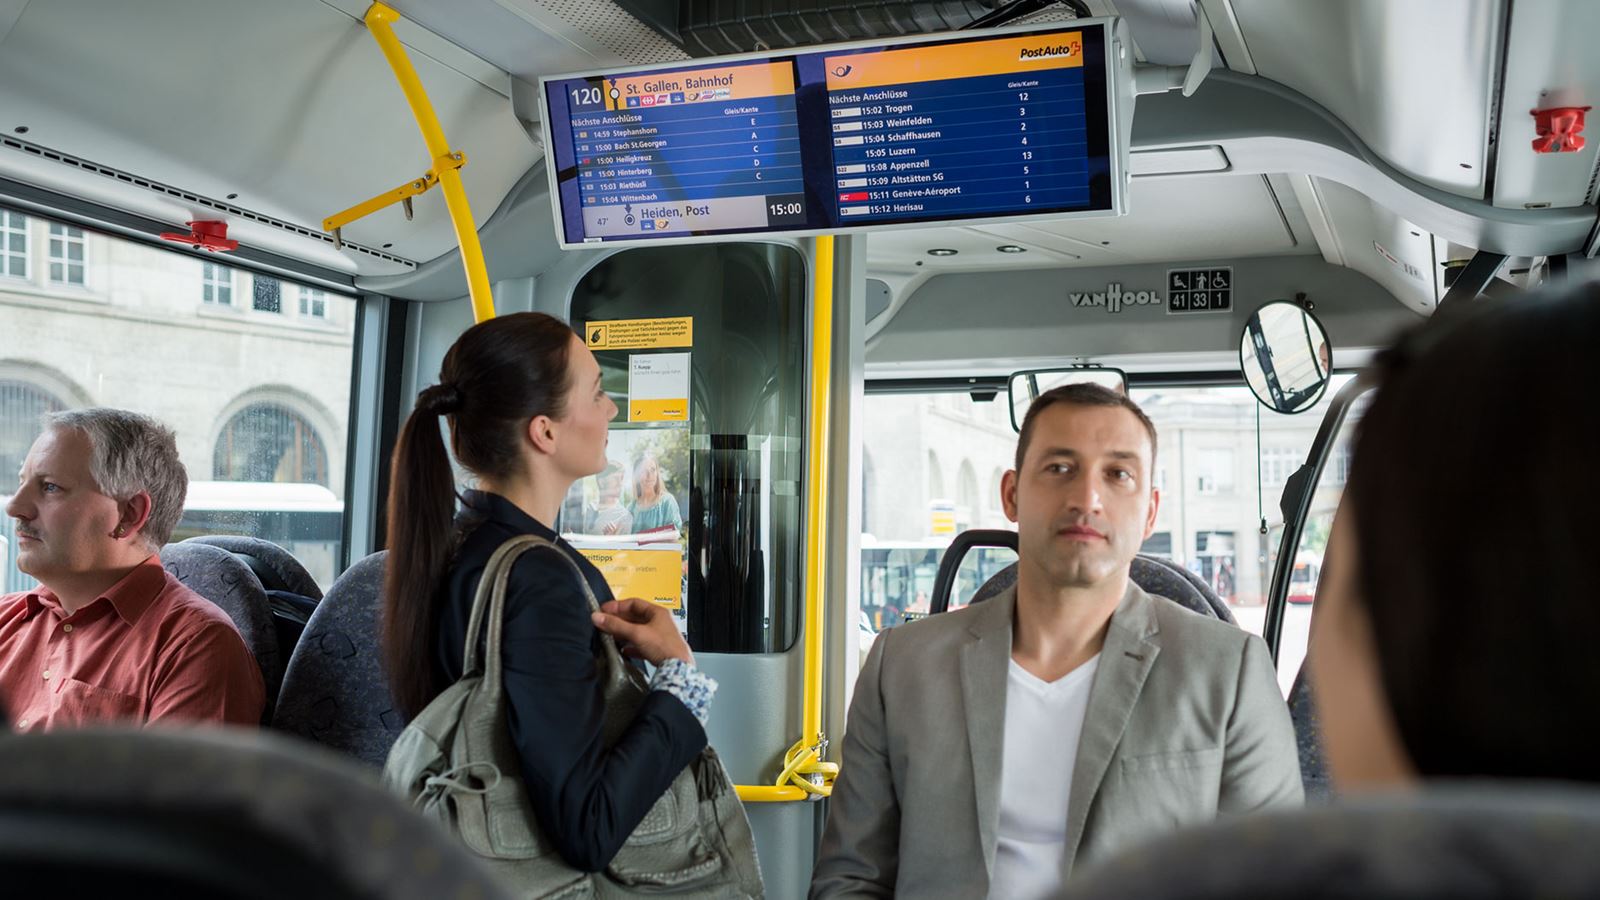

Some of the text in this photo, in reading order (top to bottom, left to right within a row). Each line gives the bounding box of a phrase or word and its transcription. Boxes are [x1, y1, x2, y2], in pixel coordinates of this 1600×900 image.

[1020, 44, 1070, 59] PostAuto
[626, 74, 734, 94] St. Gallen, Bahnhof
[1007, 79, 1039, 89] Gleis/Kante
[571, 87, 601, 105] 120
[829, 89, 908, 105] Nächste Anschlüsse
[862, 106, 882, 115] 15:02
[885, 103, 913, 115] Trogen
[1018, 92, 1028, 101] 12
[724, 106, 759, 116] Gleis/Kante
[863, 120, 883, 129] 15:03
[886, 115, 933, 128] Weinfelden
[1020, 107, 1025, 116] 3
[571, 114, 643, 128] Nächste Anschlüsse
[613, 127, 658, 138] Stephanshorn
[864, 135, 884, 143] 15:04
[887, 129, 941, 142] Schaffhausen
[1021, 122, 1026, 131] 2
[614, 142, 630, 150] Bach
[631, 140, 668, 150] St.Georgen
[865, 137, 1027, 158] 15:05 Luzern 4
[615, 154, 652, 164] Heiligkreuz
[867, 163, 887, 172] 15:08
[890, 159, 930, 173] Appenzell
[1022, 151, 1032, 160] 13
[618, 168, 652, 176] Hinterberg
[868, 177, 889, 185] 15:09
[891, 173, 931, 185] Altstätten
[933, 173, 944, 181] SG
[1023, 166, 1029, 174] 5
[620, 181, 646, 190] Riethüsli
[869, 191, 889, 200] 15:11
[892, 185, 961, 199] Genève-Aéroport
[1025, 180, 1029, 189] 1
[621, 194, 657, 202] Wittenbach
[870, 205, 890, 213] 15:12
[893, 202, 924, 213] Herisau
[1025, 195, 1031, 203] 6
[641, 204, 710, 219] Heiden, Post
[770, 202, 802, 216] 15:00
[1172, 292, 1222, 307] 41 33 1
